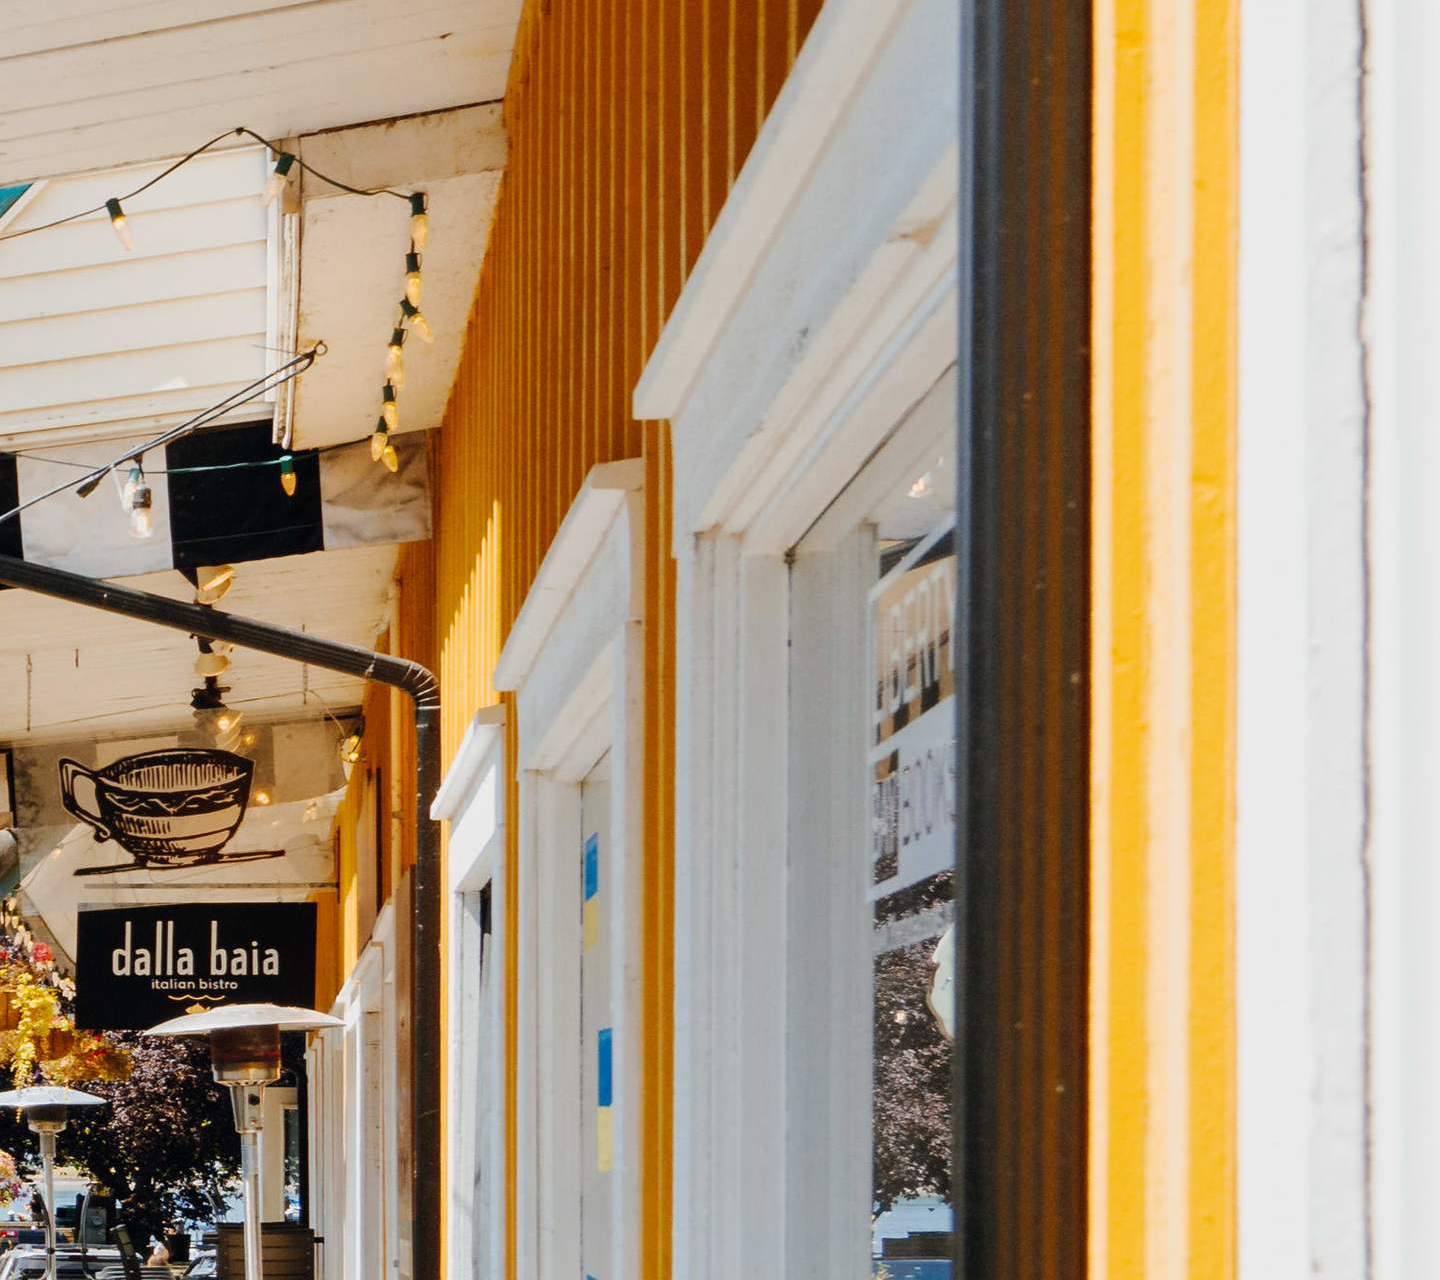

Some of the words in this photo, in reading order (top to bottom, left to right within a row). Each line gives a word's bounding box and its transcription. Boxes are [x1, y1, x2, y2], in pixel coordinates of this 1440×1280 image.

[112, 920, 194, 976] dalla
[210, 920, 280, 976] baia
[151, 978, 196, 991] italian
[199, 977, 239, 991] bistro
